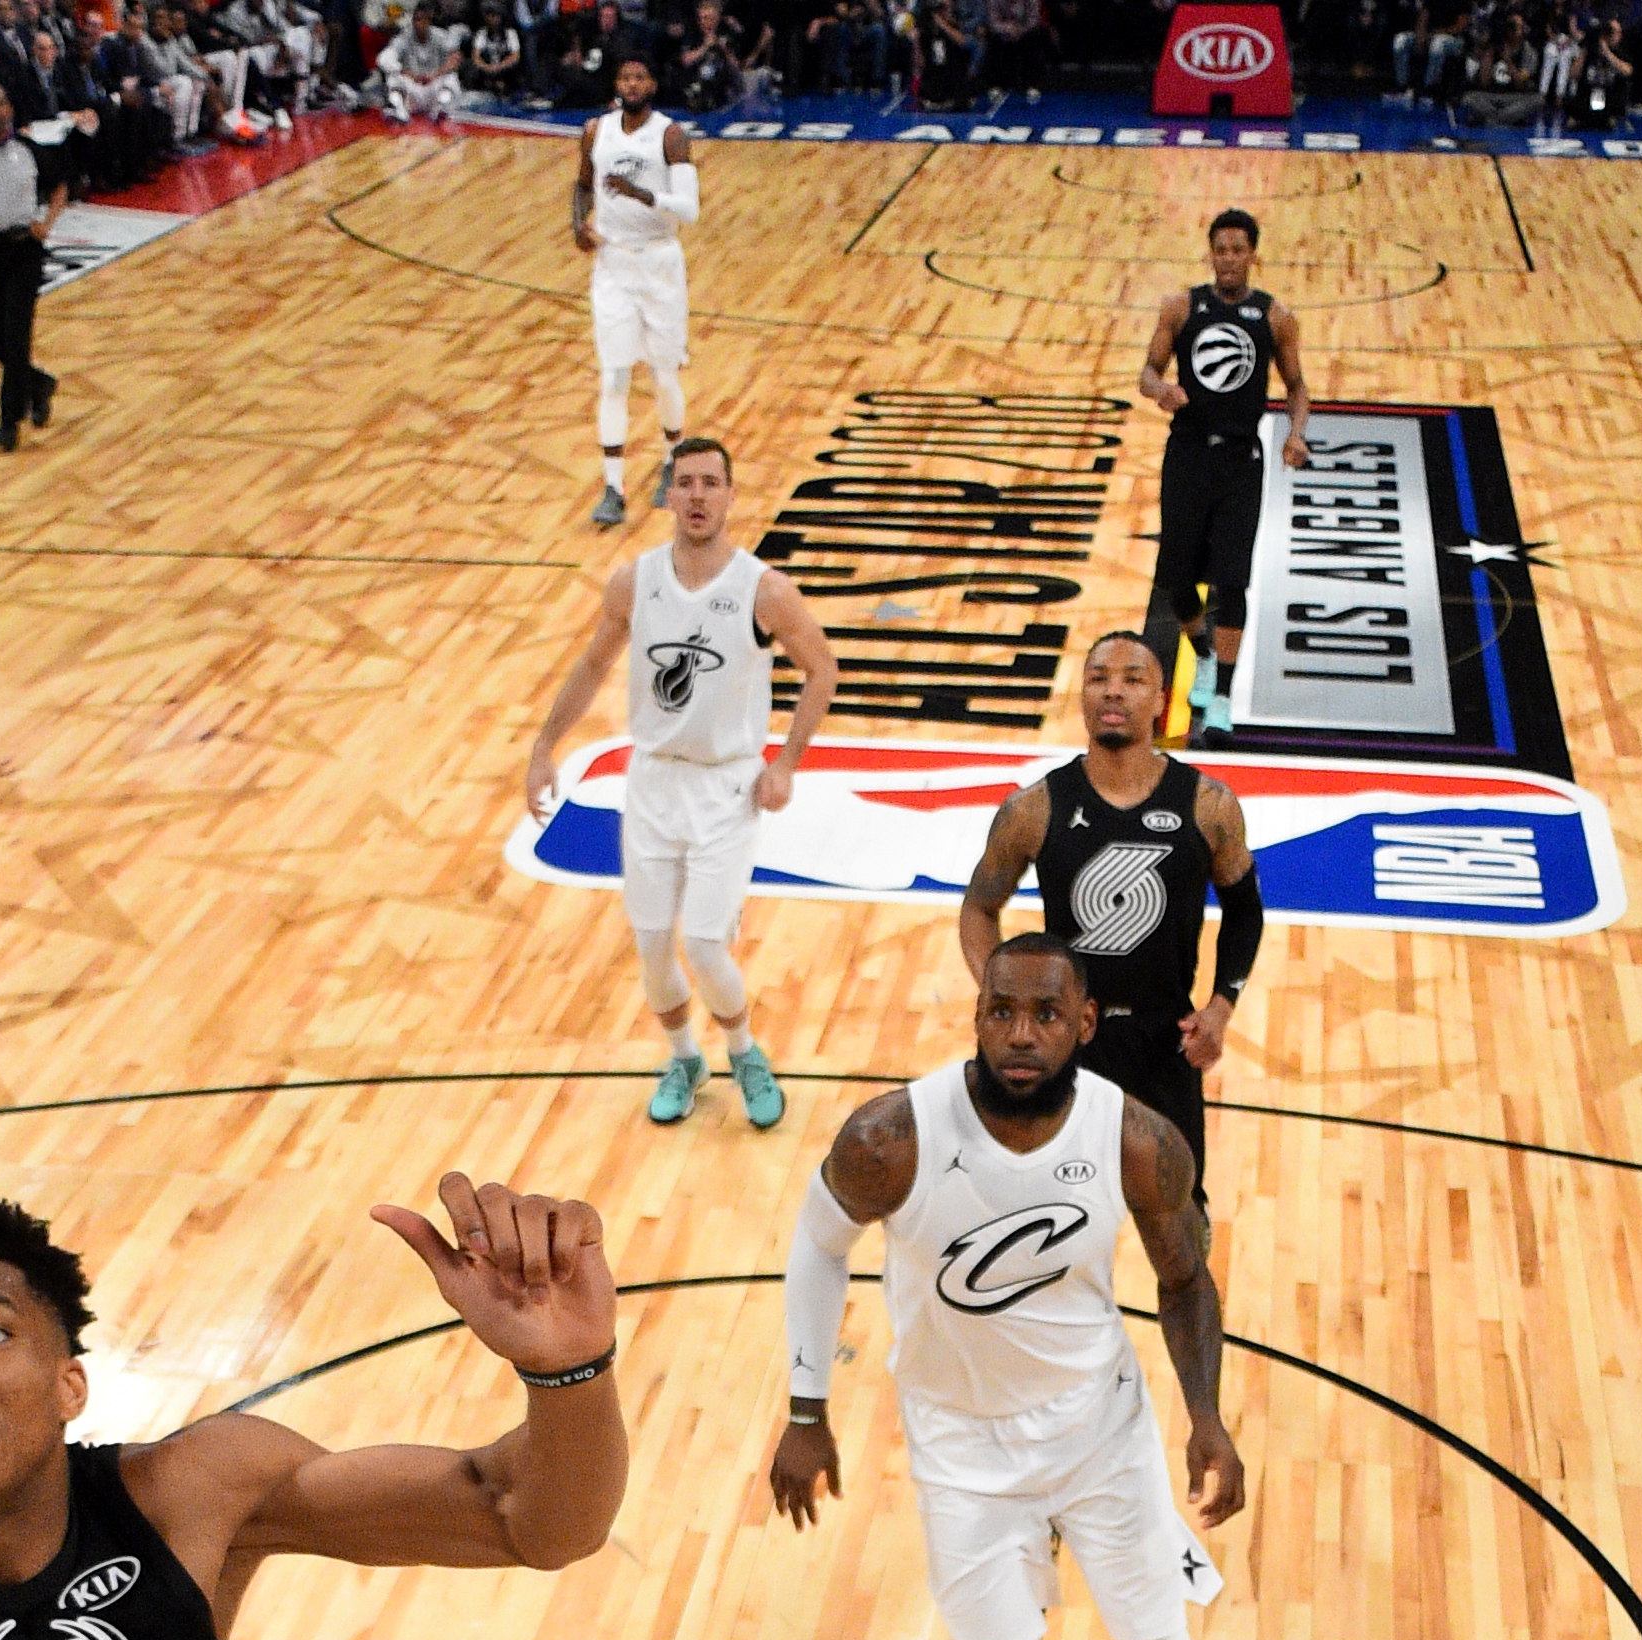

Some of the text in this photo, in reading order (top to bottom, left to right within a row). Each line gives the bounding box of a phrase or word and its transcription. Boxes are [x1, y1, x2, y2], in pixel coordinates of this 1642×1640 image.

[1191, 36, 1254, 68] KIA
[756, 391, 1132, 729] ALL STAR 2018
[1283, 438, 1415, 684] LOS ANGELES
[1148, 813, 1178, 830] KIA
[1371, 823, 1546, 910] NBA
[1061, 1163, 1090, 1180] KIA
[70, 1562, 134, 1610] KIA
